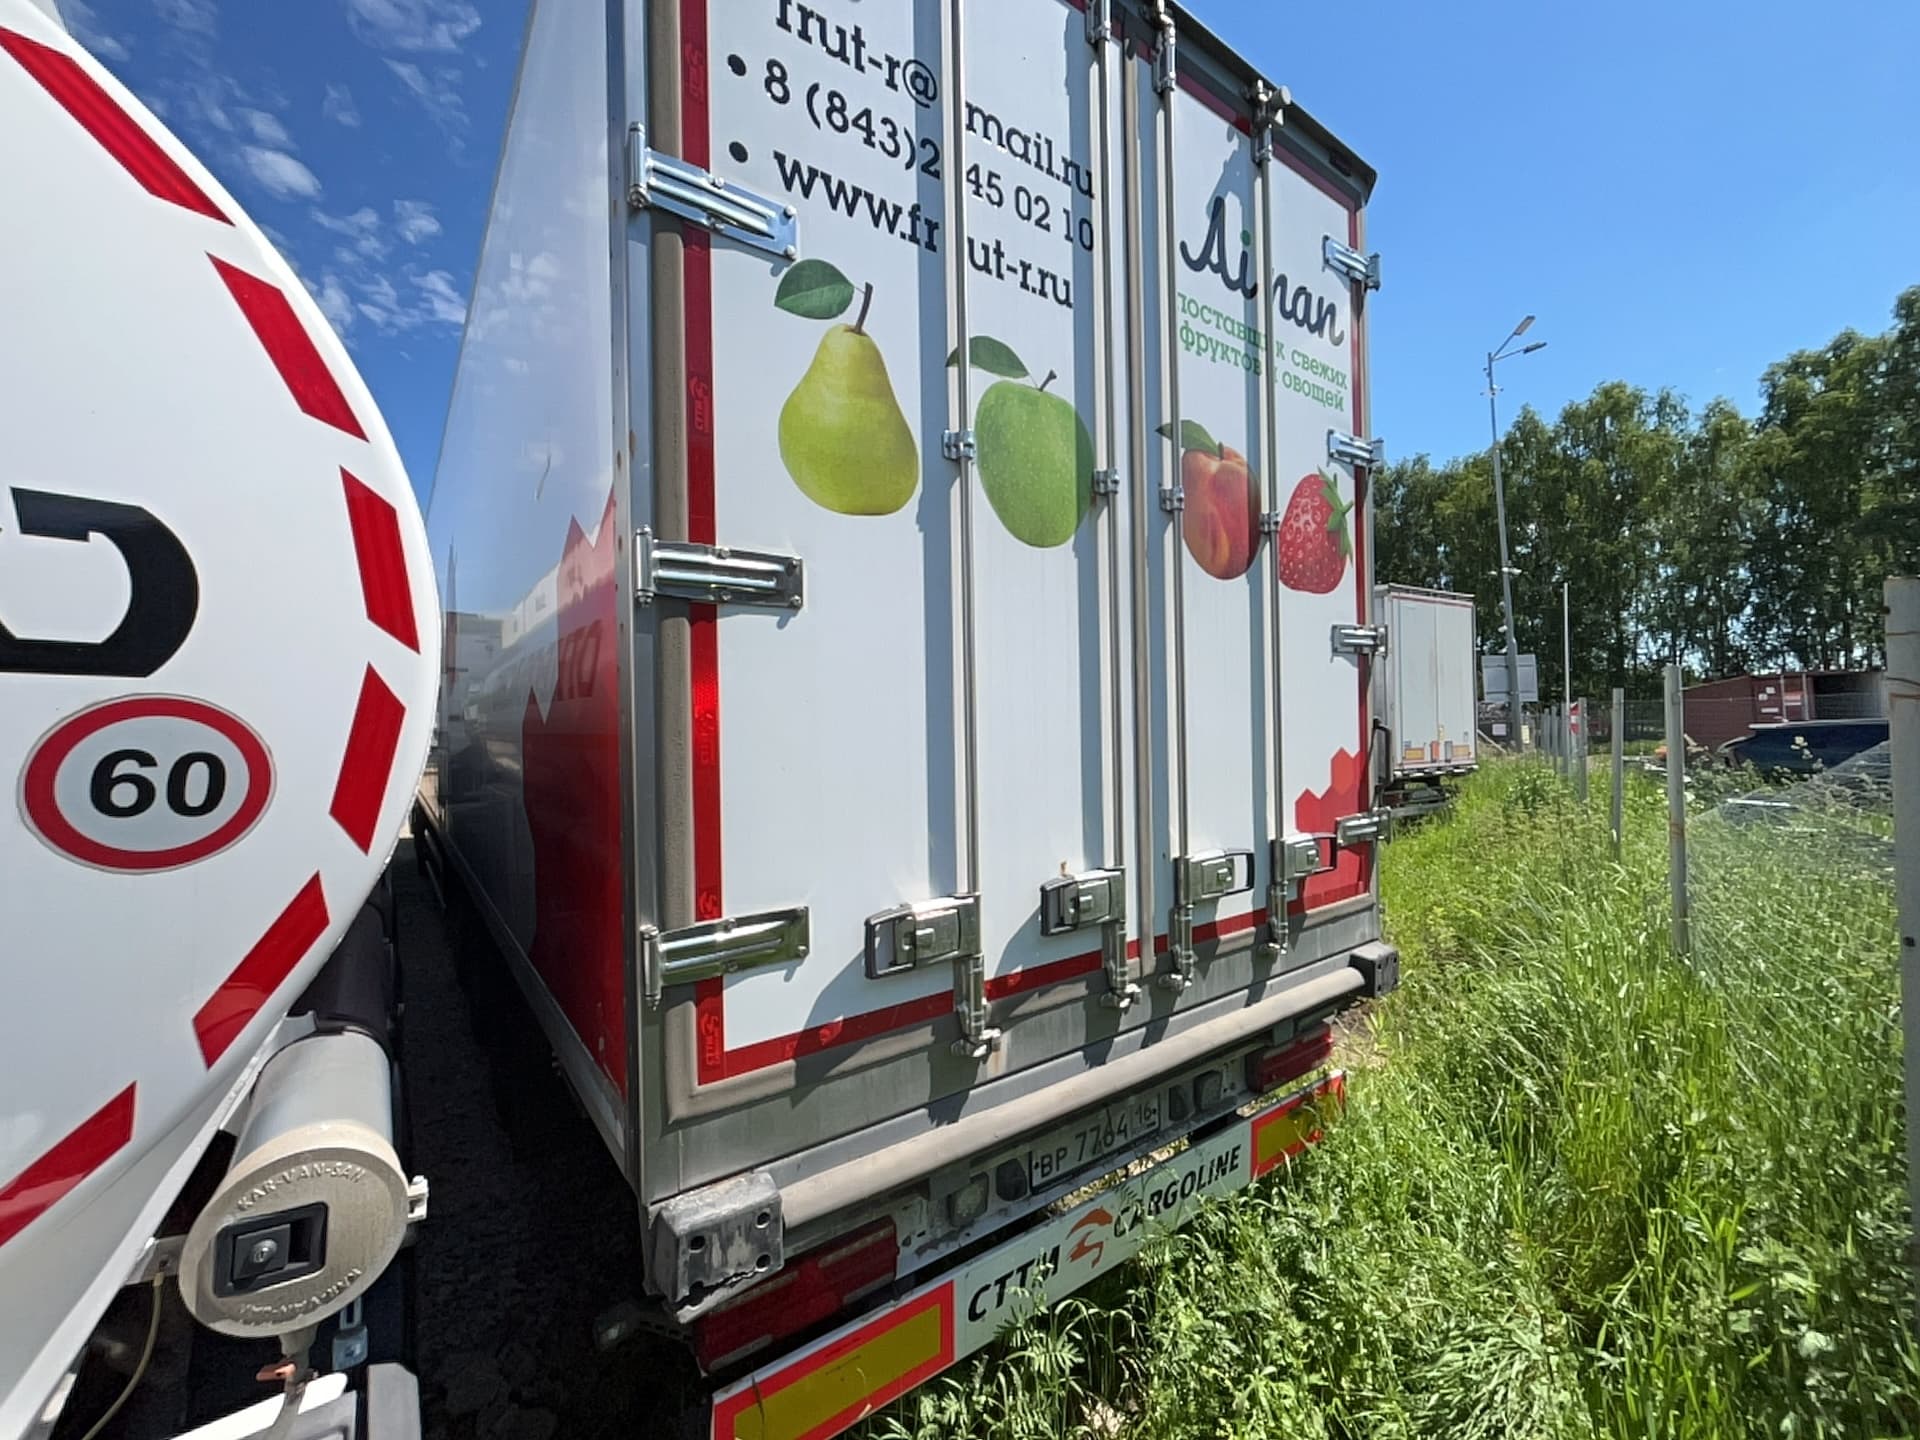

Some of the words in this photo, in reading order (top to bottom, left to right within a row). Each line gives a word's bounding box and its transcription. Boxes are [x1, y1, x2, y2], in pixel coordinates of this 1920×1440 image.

[764, 58, 790, 105] 8
[966, 163, 1002, 208] 45
[1015, 186, 1051, 232] 02
[1064, 207, 1094, 252] 10
[1282, 371, 1344, 411] овощей
[1291, 350, 1347, 390] свежих
[89, 749, 227, 818] 60
